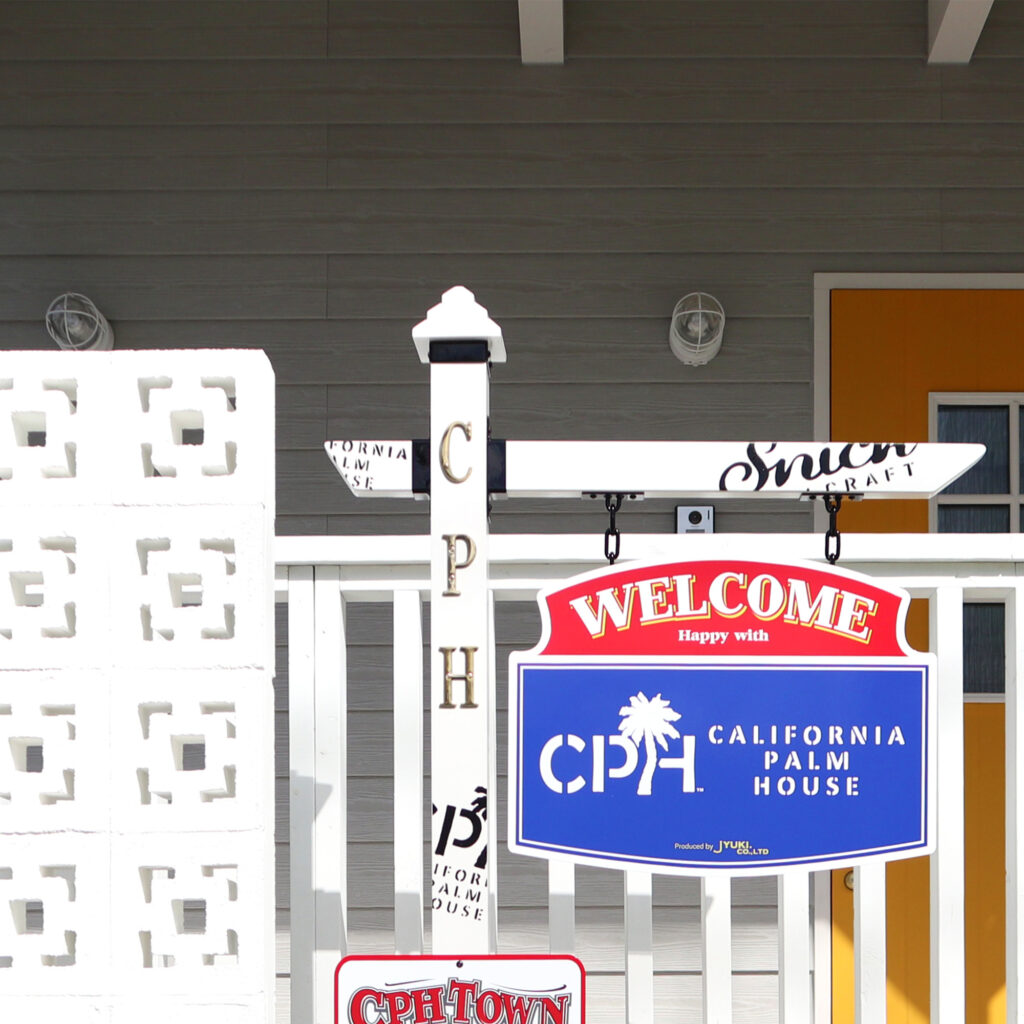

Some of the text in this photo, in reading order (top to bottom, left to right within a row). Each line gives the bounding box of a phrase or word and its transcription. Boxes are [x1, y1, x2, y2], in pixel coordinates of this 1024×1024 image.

[439, 420, 479, 709] CPH
[570, 572, 878, 644] WELCOME
[678, 629, 769, 644] Happy with
[708, 725, 906, 745] CALIFORNIA
[539, 732, 696, 796] CPH
[764, 751, 850, 771] PALM
[753, 776, 860, 796] HOUSE
[674, 842, 704, 850] Produced
[704, 843, 714, 852] by
